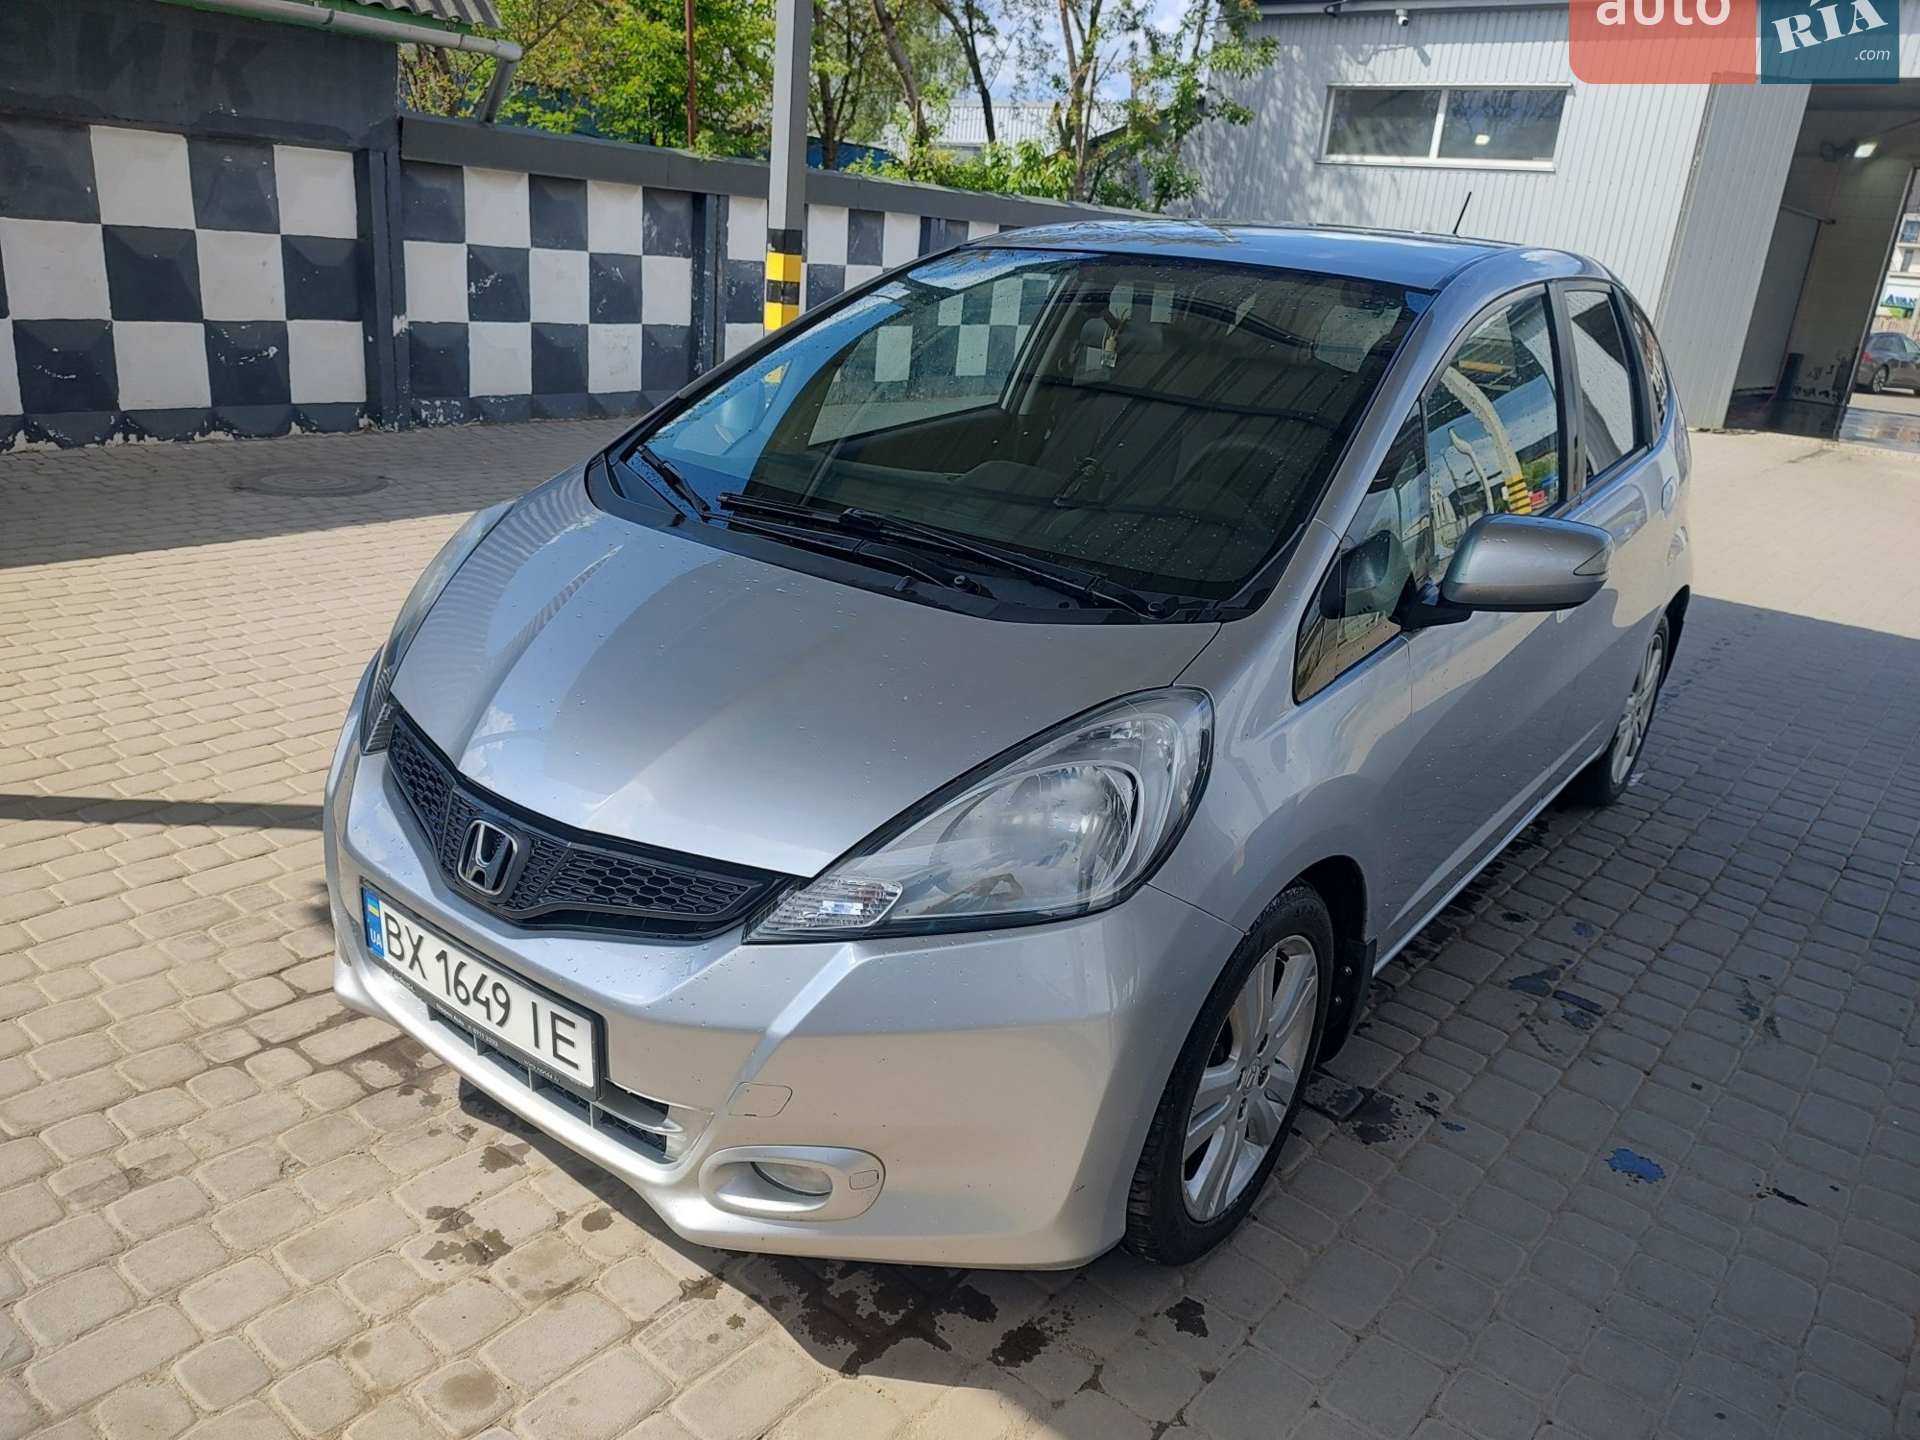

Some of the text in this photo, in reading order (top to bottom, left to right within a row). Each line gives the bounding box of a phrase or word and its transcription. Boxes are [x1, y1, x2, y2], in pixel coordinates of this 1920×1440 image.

[369, 927, 383, 949] UA
[383, 911, 580, 1071] BX 1649 IE
